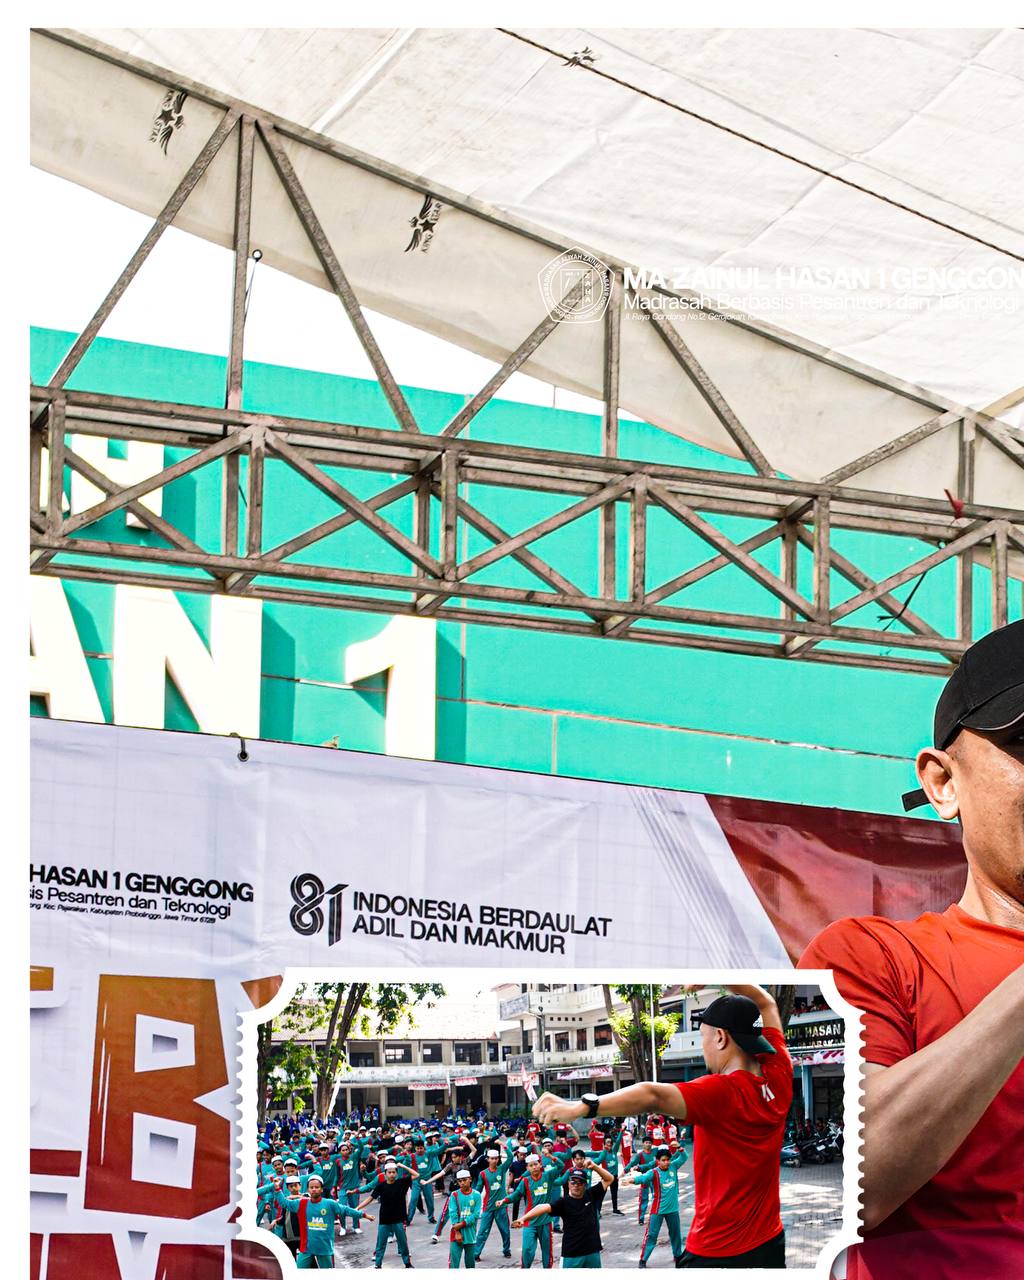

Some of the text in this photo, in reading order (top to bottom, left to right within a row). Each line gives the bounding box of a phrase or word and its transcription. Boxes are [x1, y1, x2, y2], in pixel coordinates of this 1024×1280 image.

[30, 864, 254, 902] HASAN 1 GENGGONG
[48, 887, 124, 907] Pesantren
[129, 895, 157, 910] dan
[162, 898, 231, 919] Teknologi
[290, 872, 350, 947] 81
[353, 890, 613, 937] INDONESIA BERDAULAT
[352, 914, 566, 955] ADIL DAN MAKMUR
